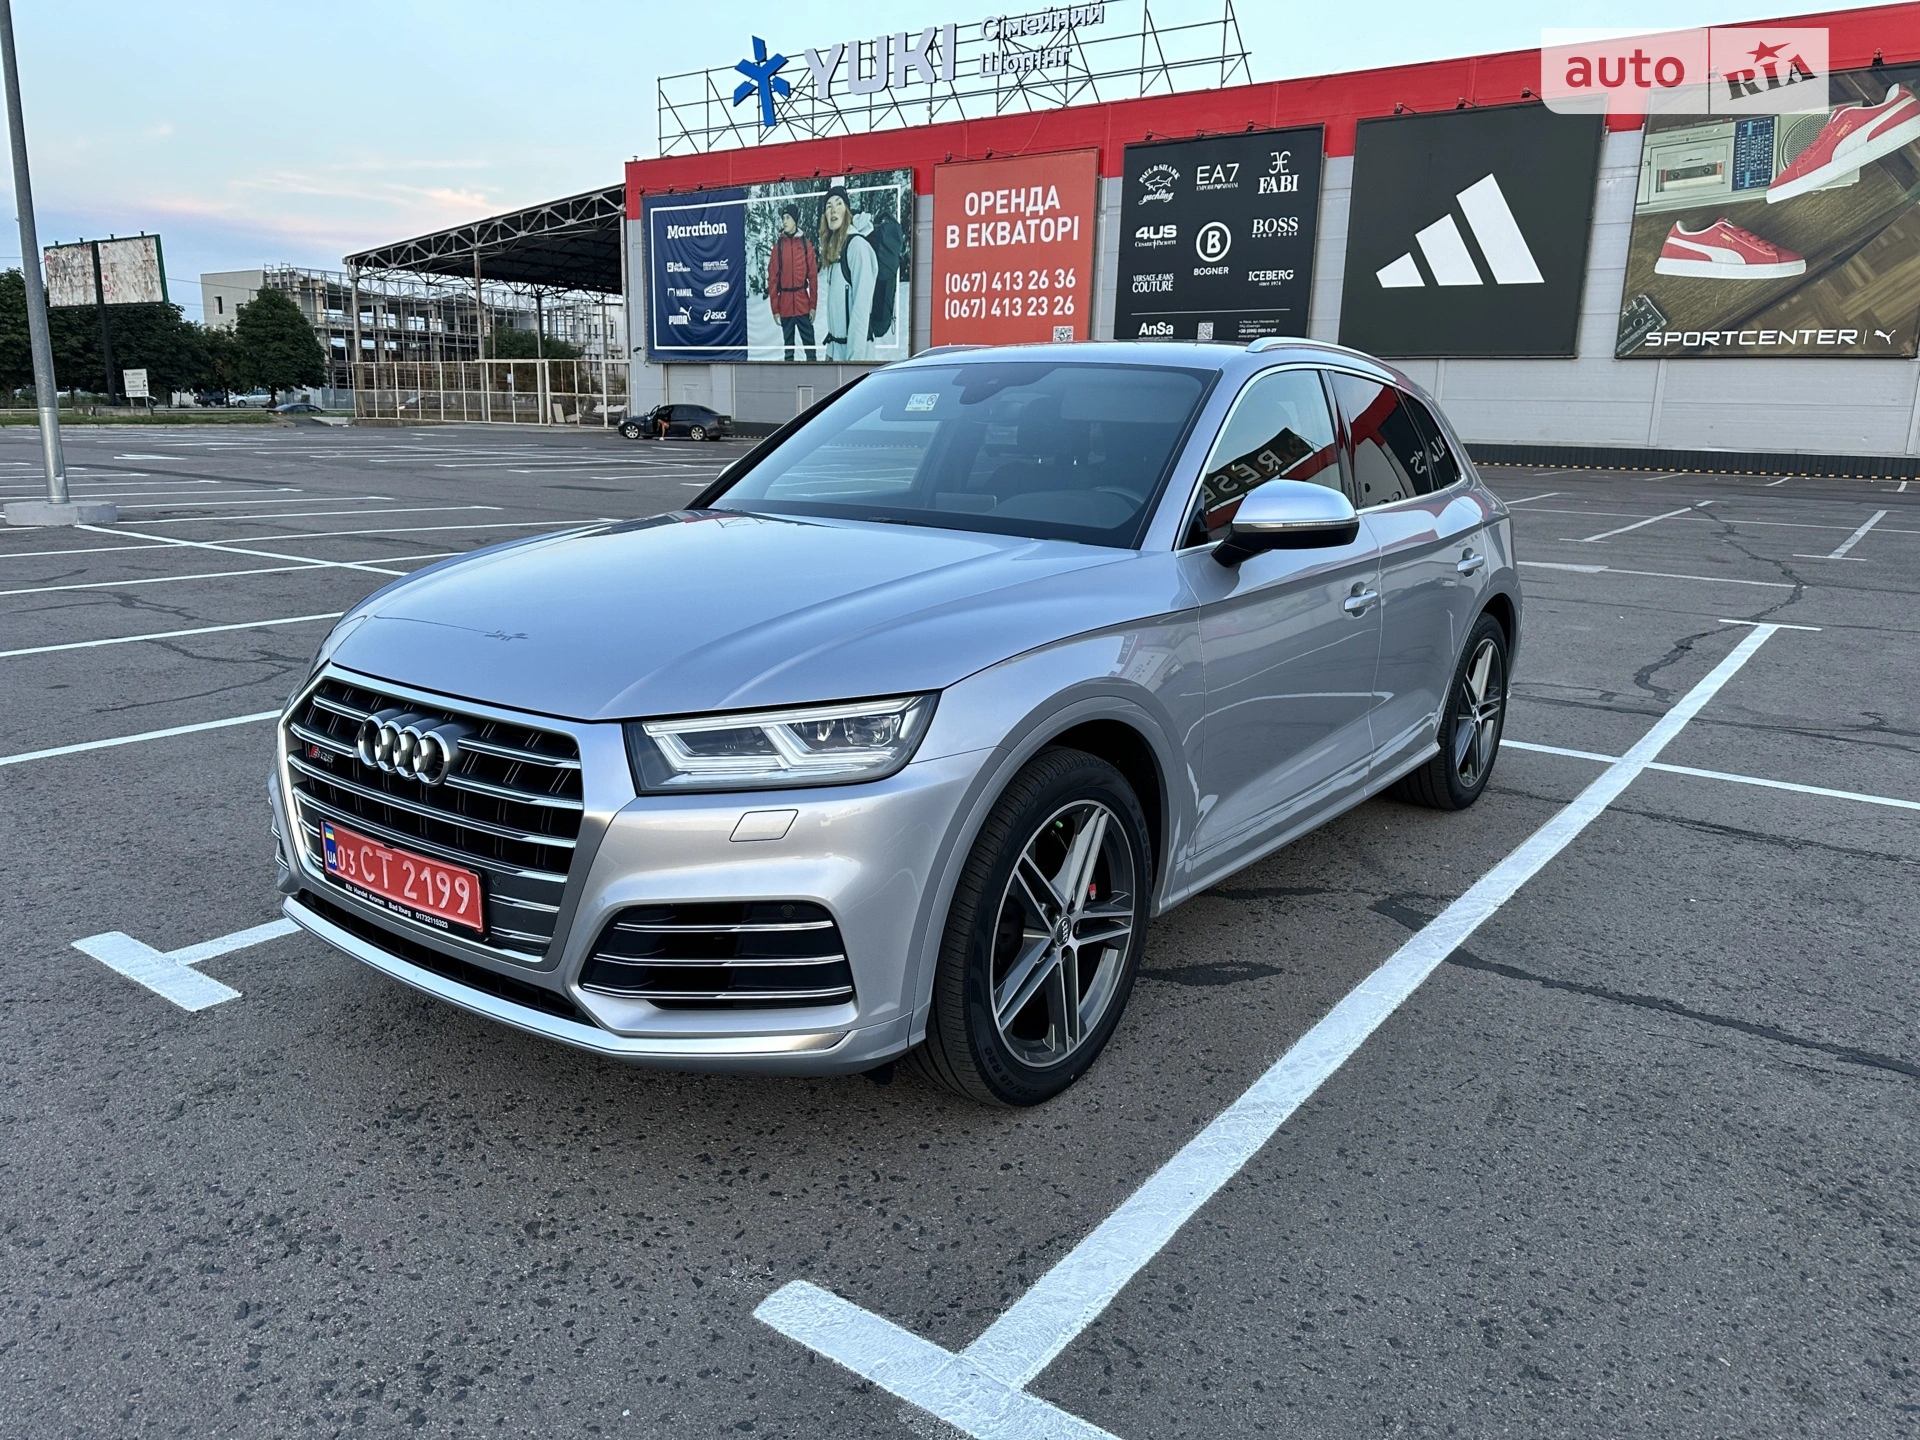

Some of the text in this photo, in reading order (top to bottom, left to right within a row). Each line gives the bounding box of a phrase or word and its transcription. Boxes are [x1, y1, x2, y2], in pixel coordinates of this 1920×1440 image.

[979, 0, 1105, 41] Сімейний
[803, 23, 957, 100] YUKI
[979, 45, 1073, 78] Шопінг
[1196, 163, 1240, 185] EA7
[1257, 174, 1299, 194] FABI
[965, 185, 1061, 216] ОРЕНДА
[1138, 188, 1174, 205] yachting
[666, 221, 727, 239] Marathon
[946, 216, 1079, 248] В ЕКВАТОРІ
[1135, 224, 1177, 240] 4US
[1252, 217, 1299, 234] BOSS
[1133, 273, 1174, 282] VERSACE JEANS
[1193, 266, 1229, 276] BOGNER
[1247, 269, 1294, 281] ICEBERG
[705, 284, 728, 295] KEEN
[945, 268, 1076, 295] (067) 413 26 36
[1132, 280, 1174, 293] COUTURE
[944, 295, 1075, 320] (067) 413 23 26
[1138, 321, 1174, 335] AnSa
[1645, 329, 1858, 347] SPORTCENTER
[327, 850, 338, 866] UA
[402, 860, 470, 915] 2199
